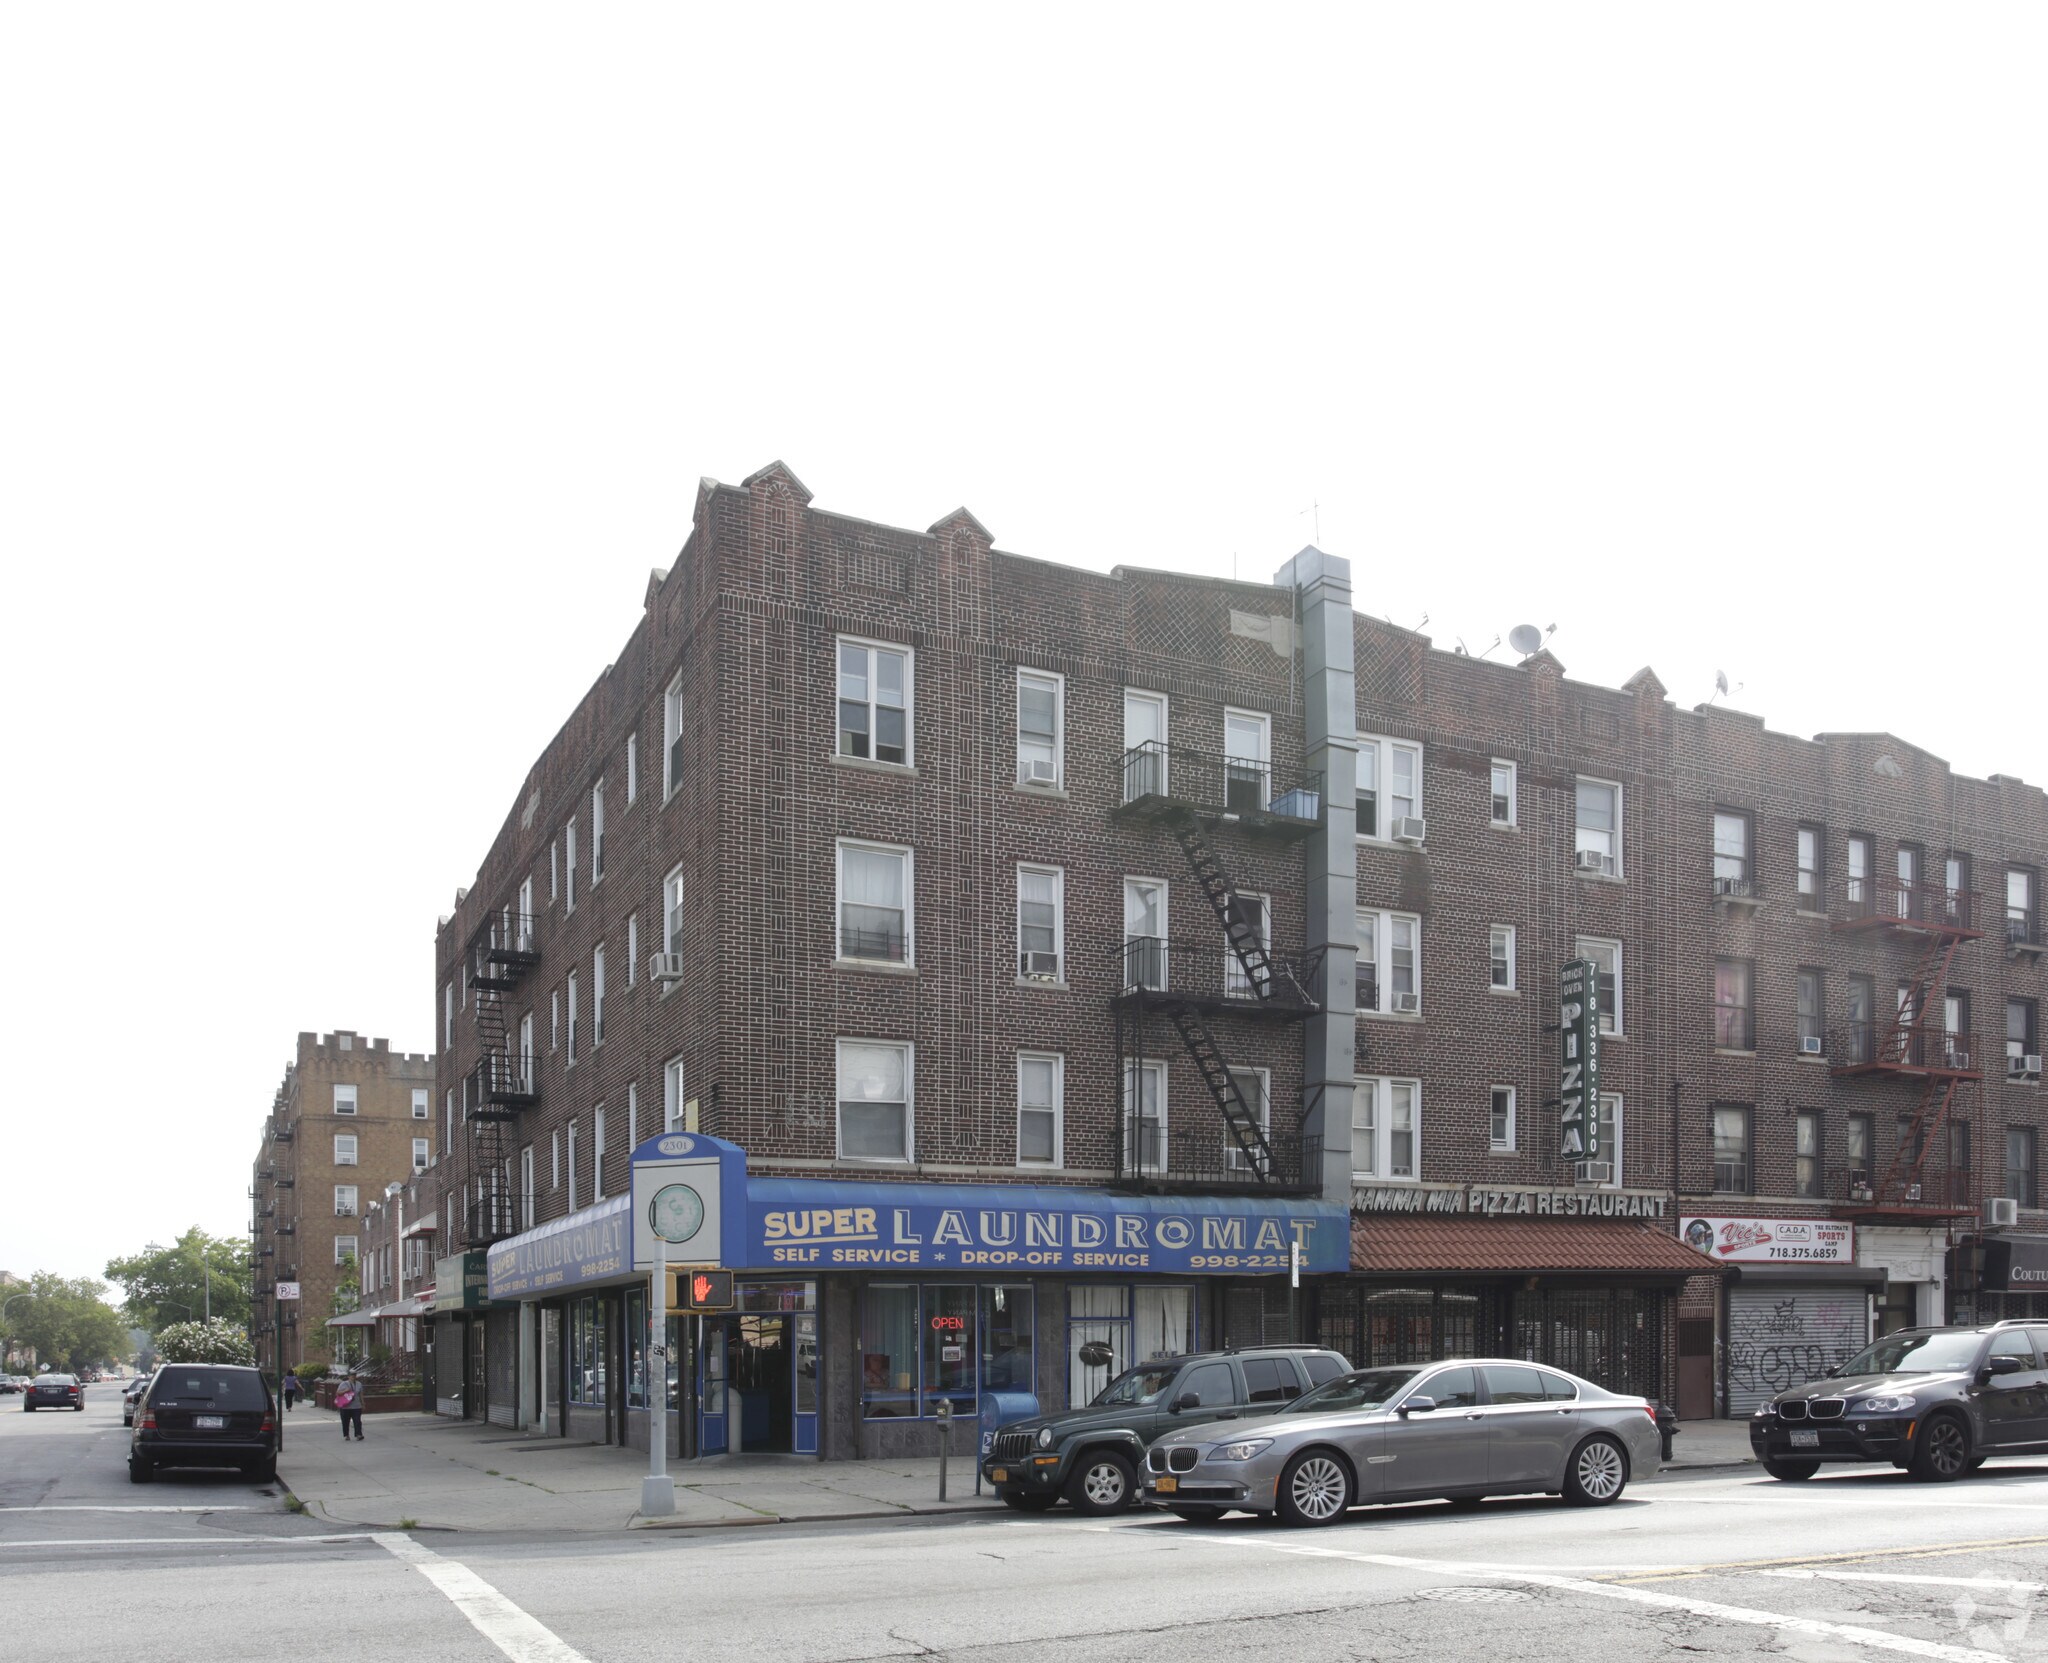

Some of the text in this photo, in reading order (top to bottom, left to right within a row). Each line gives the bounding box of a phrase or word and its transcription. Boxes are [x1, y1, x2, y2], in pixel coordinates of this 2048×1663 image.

[1562, 966, 1583, 981] BRICK
[1563, 982, 1583, 996] OVEN
[1562, 1002, 1583, 1154] PIZZA
[663, 1142, 688, 1151] 2301
[1350, 1187, 1667, 1217] MAMMA MIA PIZZA RESTAURANT
[764, 1207, 1317, 1251] SUPER LAUNDROMAT
[1719, 1221, 1766, 1243] Vic's
[1779, 1226, 1808, 1234] C.A.D.A.
[1817, 1232, 1846, 1240] SPORTS
[491, 1218, 623, 1277] SUPER LAUNDROMAT
[1769, 1248, 1838, 1259] 718.375.6859
[773, 1248, 1149, 1266] SELF SERVICE DROP-OFF SERVICE
[1190, 1255, 1310, 1268] 998-2254
[581, 1257, 621, 1278] 998-2254
[545, 1270, 563, 1284] SERVICE
[931, 1317, 964, 1330] OPEN
